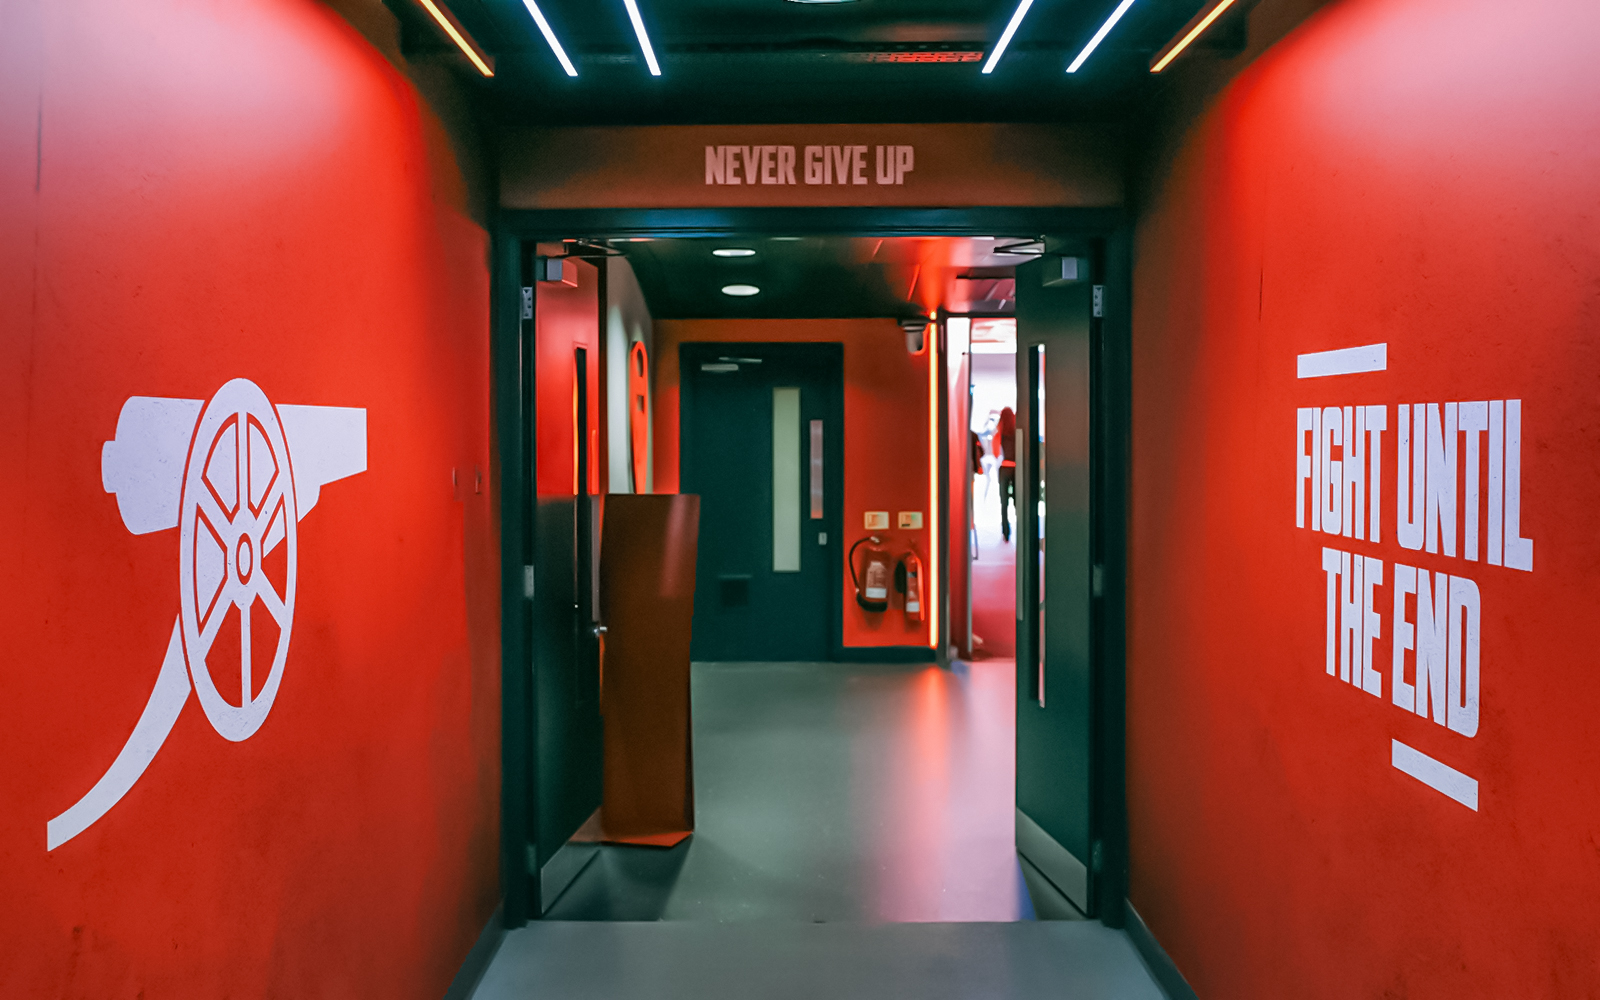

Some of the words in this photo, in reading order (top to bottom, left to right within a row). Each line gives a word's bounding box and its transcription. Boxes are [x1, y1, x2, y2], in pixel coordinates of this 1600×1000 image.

[705, 145, 797, 185] NEVER
[804, 145, 868, 185] GIVE
[875, 145, 915, 185] UP
[1296, 405, 1387, 543] FIGHT
[1397, 399, 1533, 572] UNTIL
[1322, 547, 1383, 698] THE
[1392, 562, 1481, 738] END
